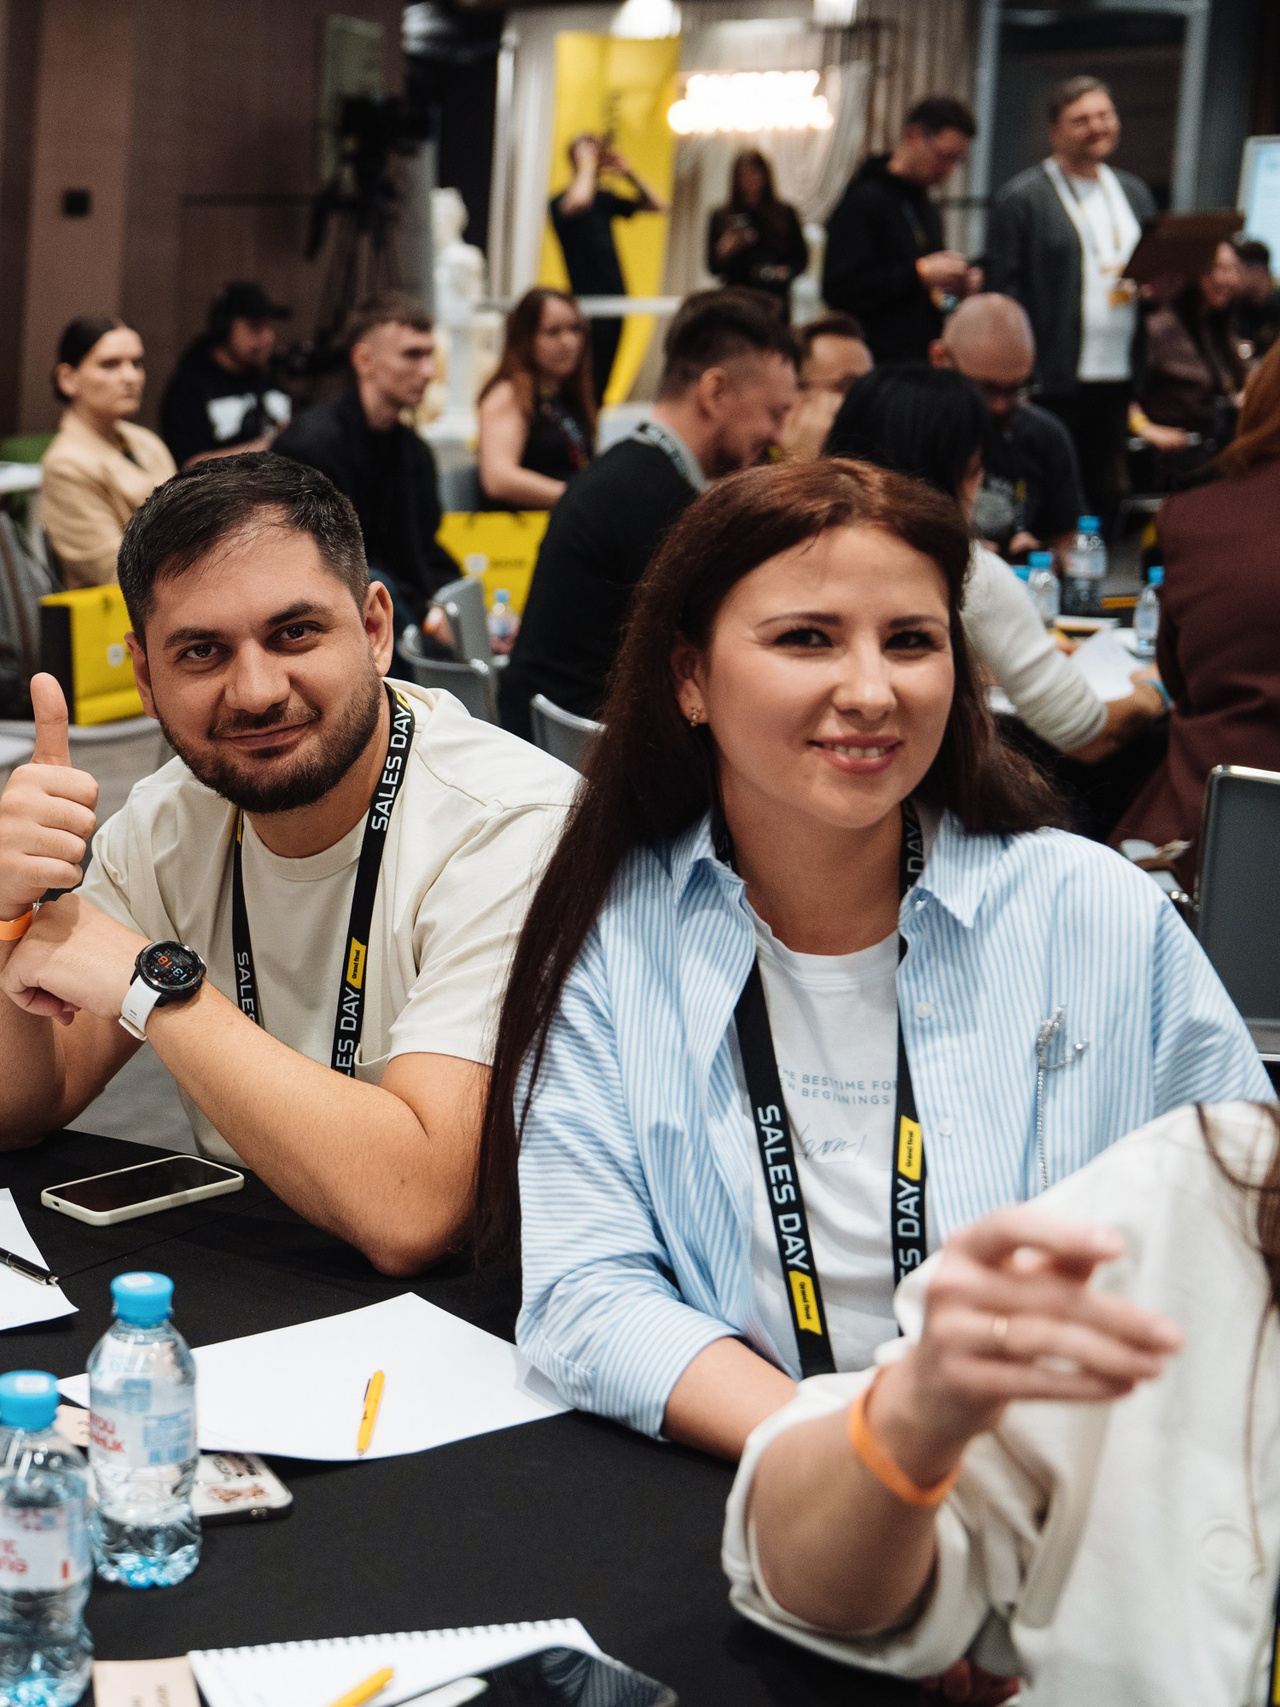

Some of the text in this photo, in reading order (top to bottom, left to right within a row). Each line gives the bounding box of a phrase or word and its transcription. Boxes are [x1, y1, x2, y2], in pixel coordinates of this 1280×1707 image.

[371, 704, 412, 832] SALES DAY
[340, 986, 360, 1031] DAY
[757, 1104, 797, 1204] SALES
[778, 1212, 810, 1271] DAY
[896, 1178, 920, 1237] DAY
